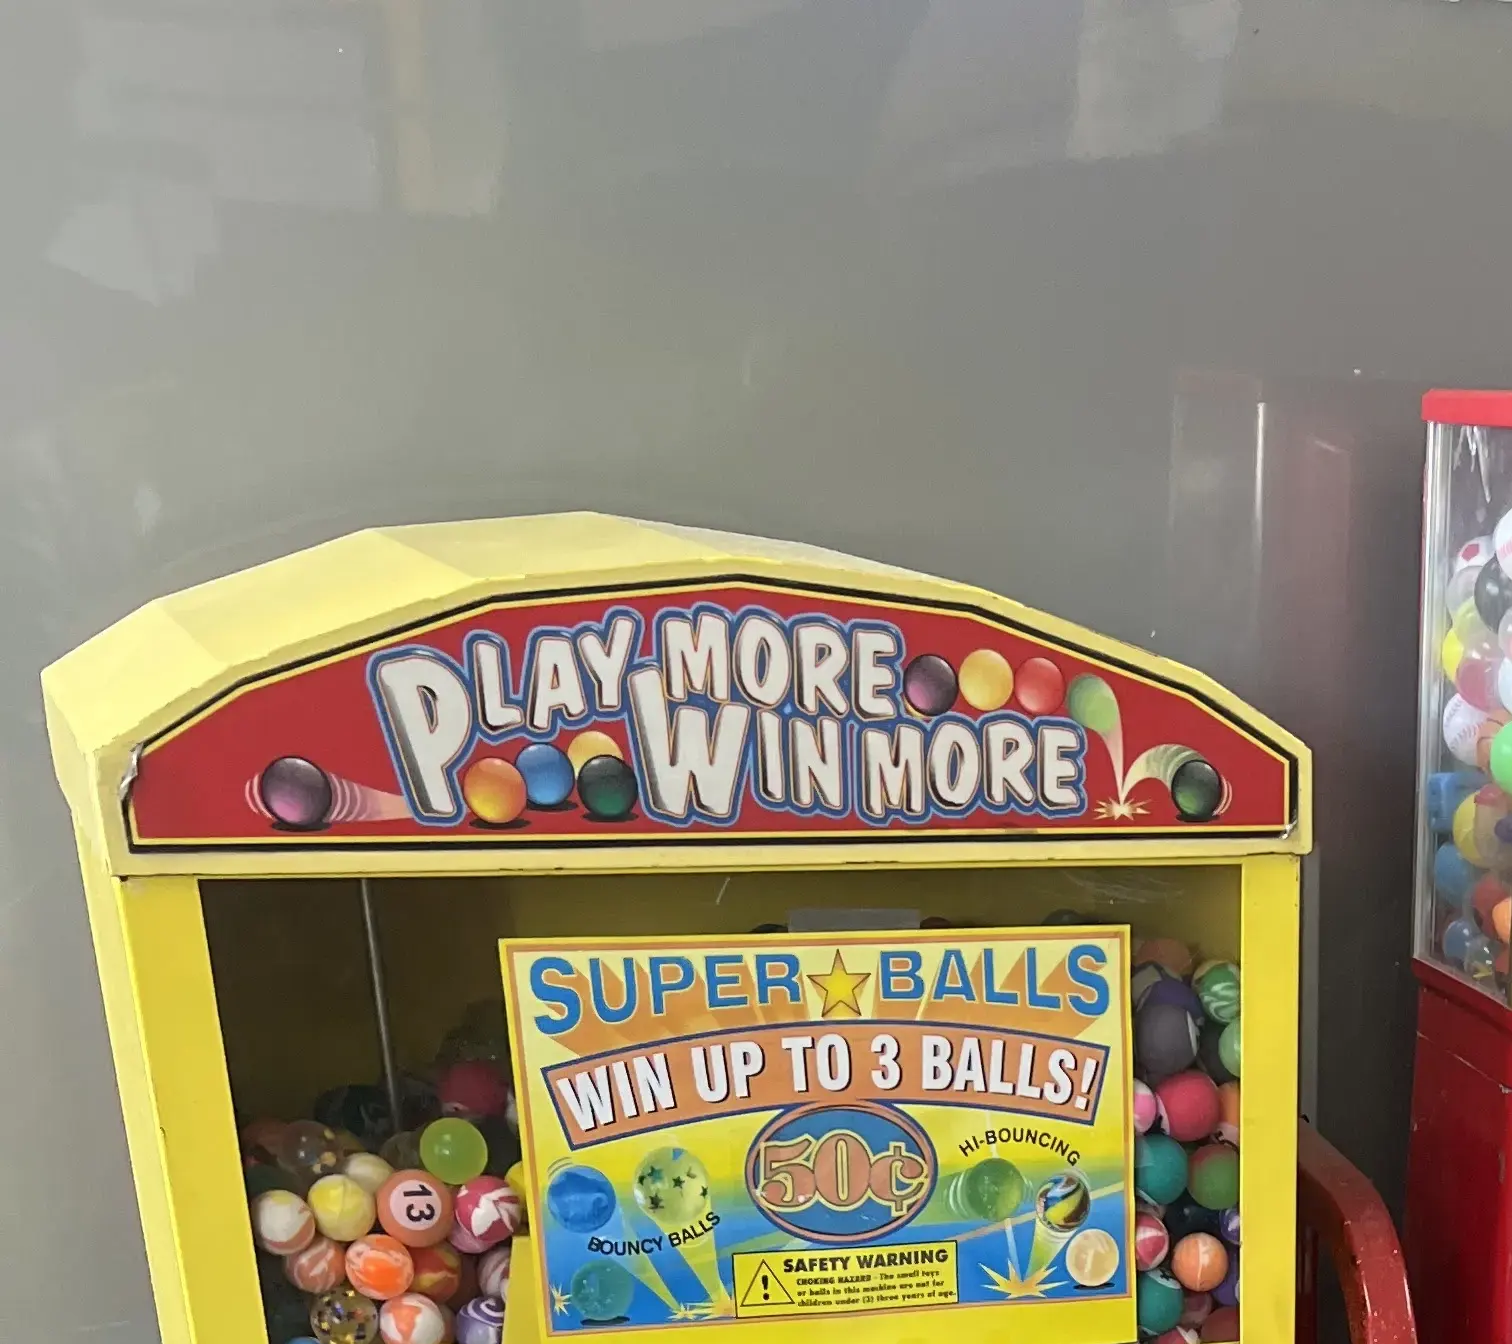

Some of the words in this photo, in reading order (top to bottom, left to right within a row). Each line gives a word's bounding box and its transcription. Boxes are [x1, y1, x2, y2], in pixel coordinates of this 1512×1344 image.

[372, 608, 636, 822] PLAY
[660, 612, 900, 722] MORE
[632, 666, 856, 822] WIN
[863, 718, 1091, 819] MORE
[528, 952, 803, 1036] SUPER
[878, 944, 1113, 1017] BALLS
[556, 1050, 678, 1134] WIN
[690, 1041, 765, 1099] UP
[781, 1032, 851, 1092] TO
[869, 1033, 902, 1091] 3
[921, 1033, 1103, 1112] BALLS!
[957, 1126, 1082, 1168] HI-BOUNCING
[756, 1127, 928, 1213] 50¢
[402, 1184, 437, 1224] 13
[587, 1234, 664, 1257] BOUNCY
[666, 1210, 723, 1249] BALLS
[783, 1256, 850, 1273] SAFETY
[857, 1248, 949, 1270] WARNING
[796, 1276, 835, 1286] CHOKING
[838, 1274, 872, 1285] HAZARD
[879, 1273, 894, 1281] The
[896, 1270, 920, 1279] small
[797, 1297, 833, 1307] children
[835, 1296, 861, 1305] under
[876, 1293, 899, 1302] three
[844, 1285, 861, 1294] this
